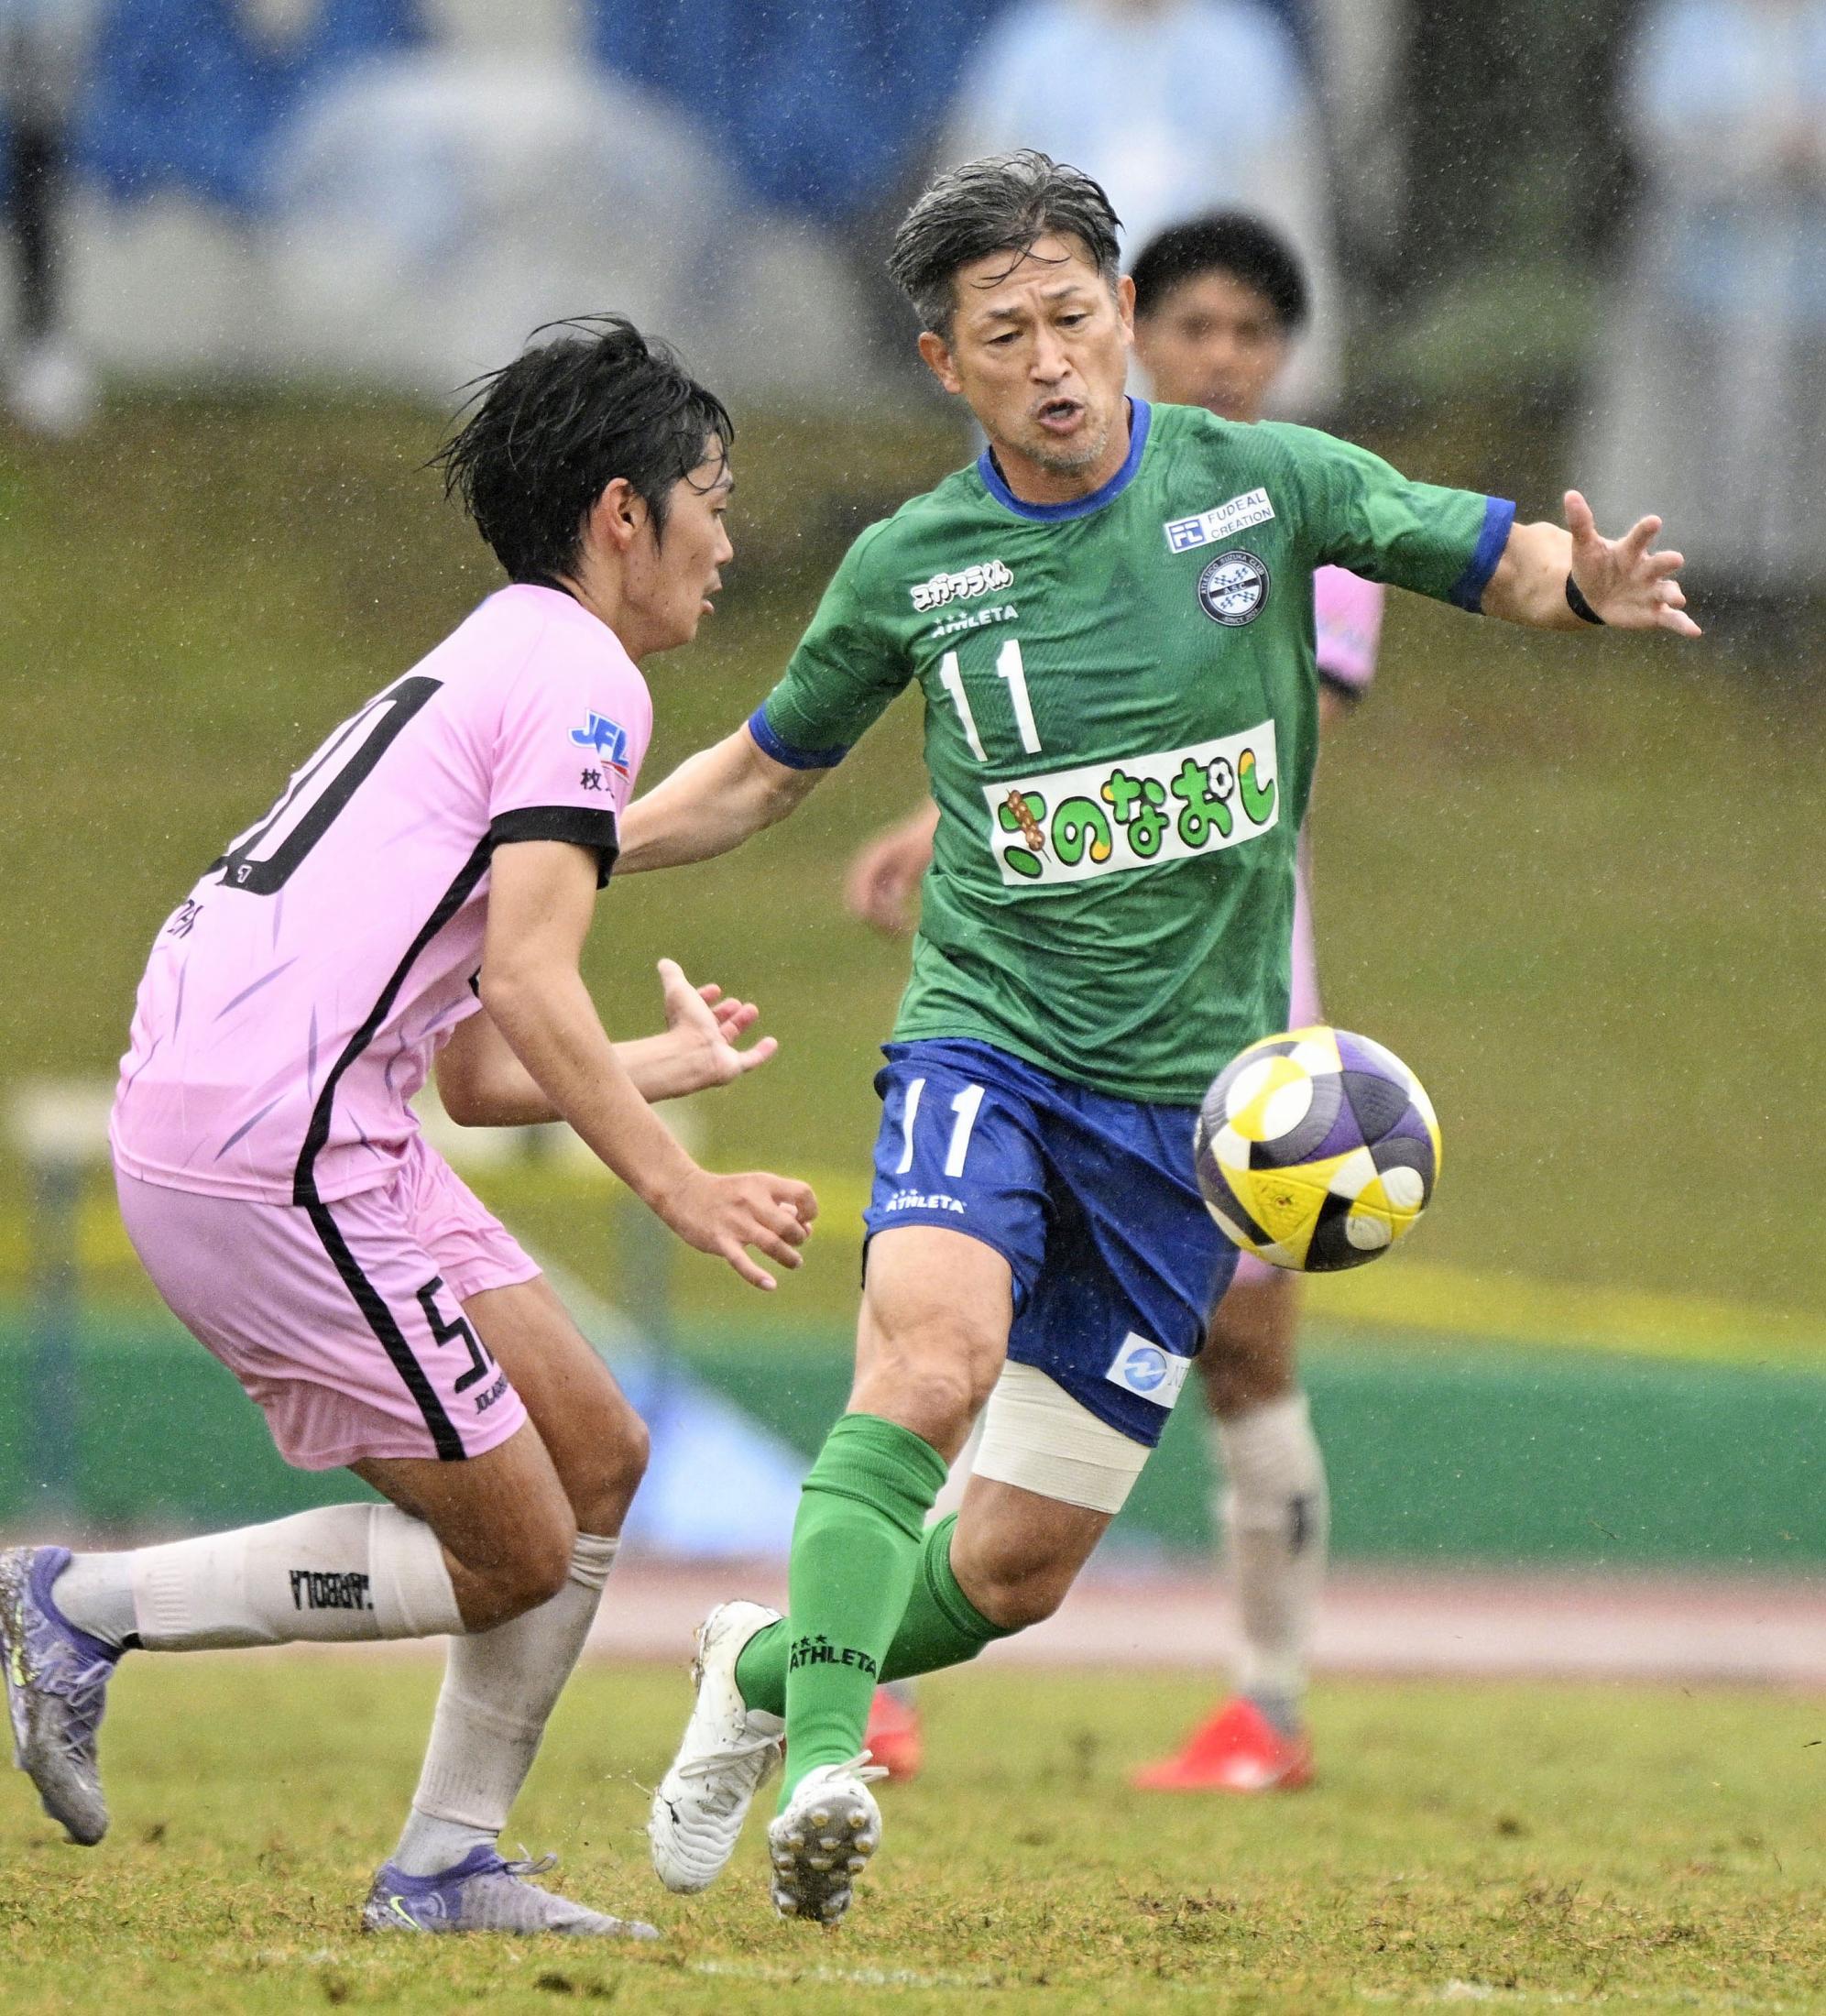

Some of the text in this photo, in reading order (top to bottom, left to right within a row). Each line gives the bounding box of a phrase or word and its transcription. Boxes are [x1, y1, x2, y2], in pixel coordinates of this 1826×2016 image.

[1208, 493, 1266, 523] FUDEAL
[1210, 508, 1273, 539] CREATION
[1220, 553, 1247, 564] SUZUKA
[1249, 559, 1265, 575] CLUB
[939, 639, 1043, 762] 11
[567, 708, 630, 769] JFL
[580, 768, 615, 799] 枚
[998, 747, 1276, 879] さのなおし
[895, 1078, 986, 1178] 11
[885, 1194, 965, 1214] ATHLETA
[416, 1275, 495, 1395] 5
[789, 1645, 877, 1679] ATHLETA
